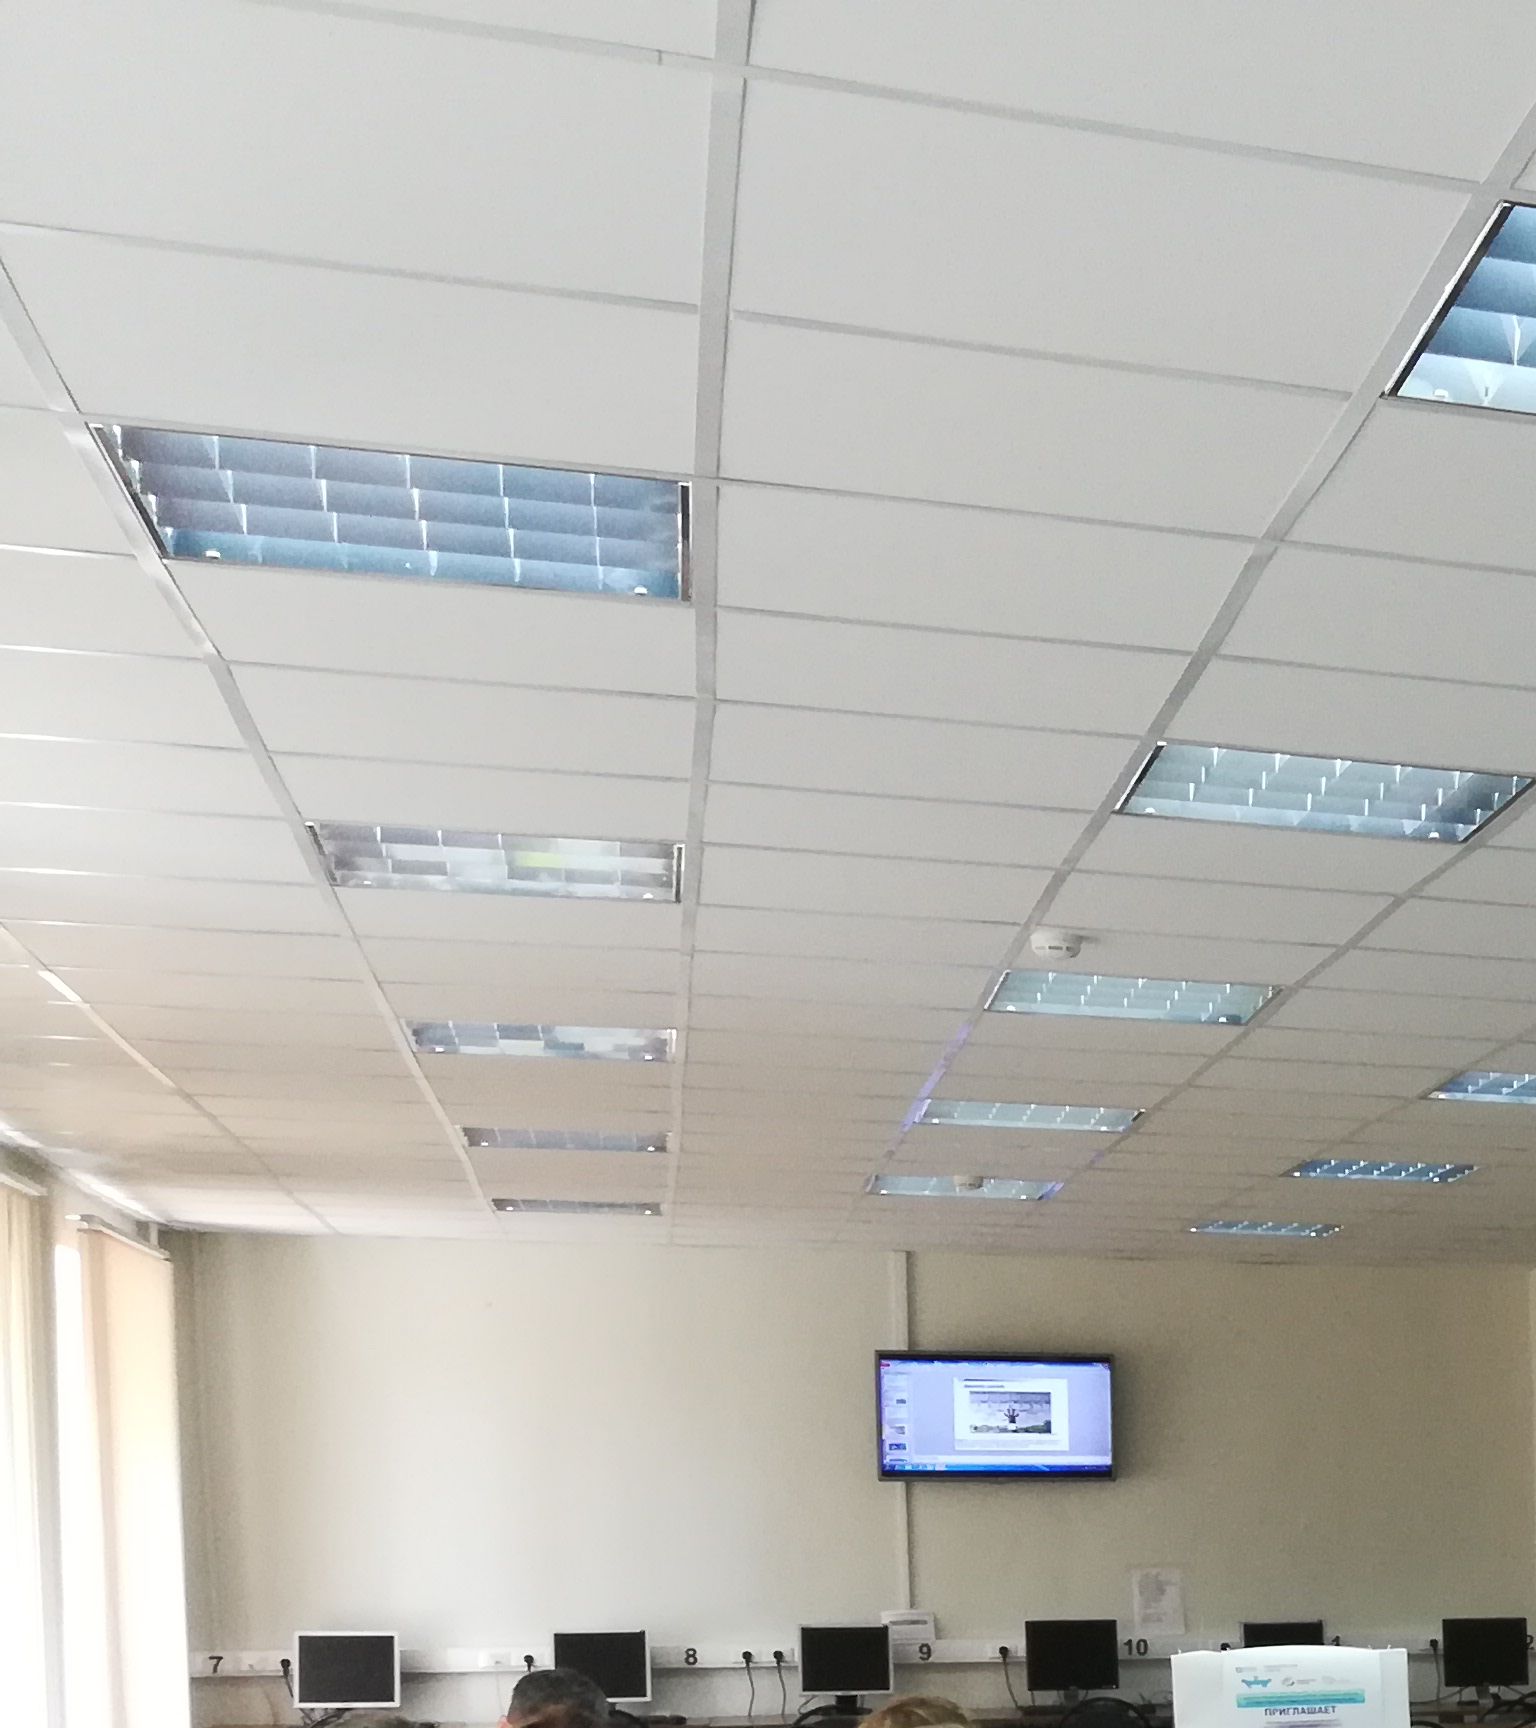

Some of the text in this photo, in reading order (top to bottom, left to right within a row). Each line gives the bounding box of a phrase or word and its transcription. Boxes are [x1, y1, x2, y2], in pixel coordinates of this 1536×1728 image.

[918, 1643, 932, 1661] 9
[1123, 1638, 1149, 1656] 10
[208, 1655, 224, 1674] 7
[684, 1647, 698, 1666] 8
[1264, 1705, 1337, 1716] ПРИГЛАШАЕТ
